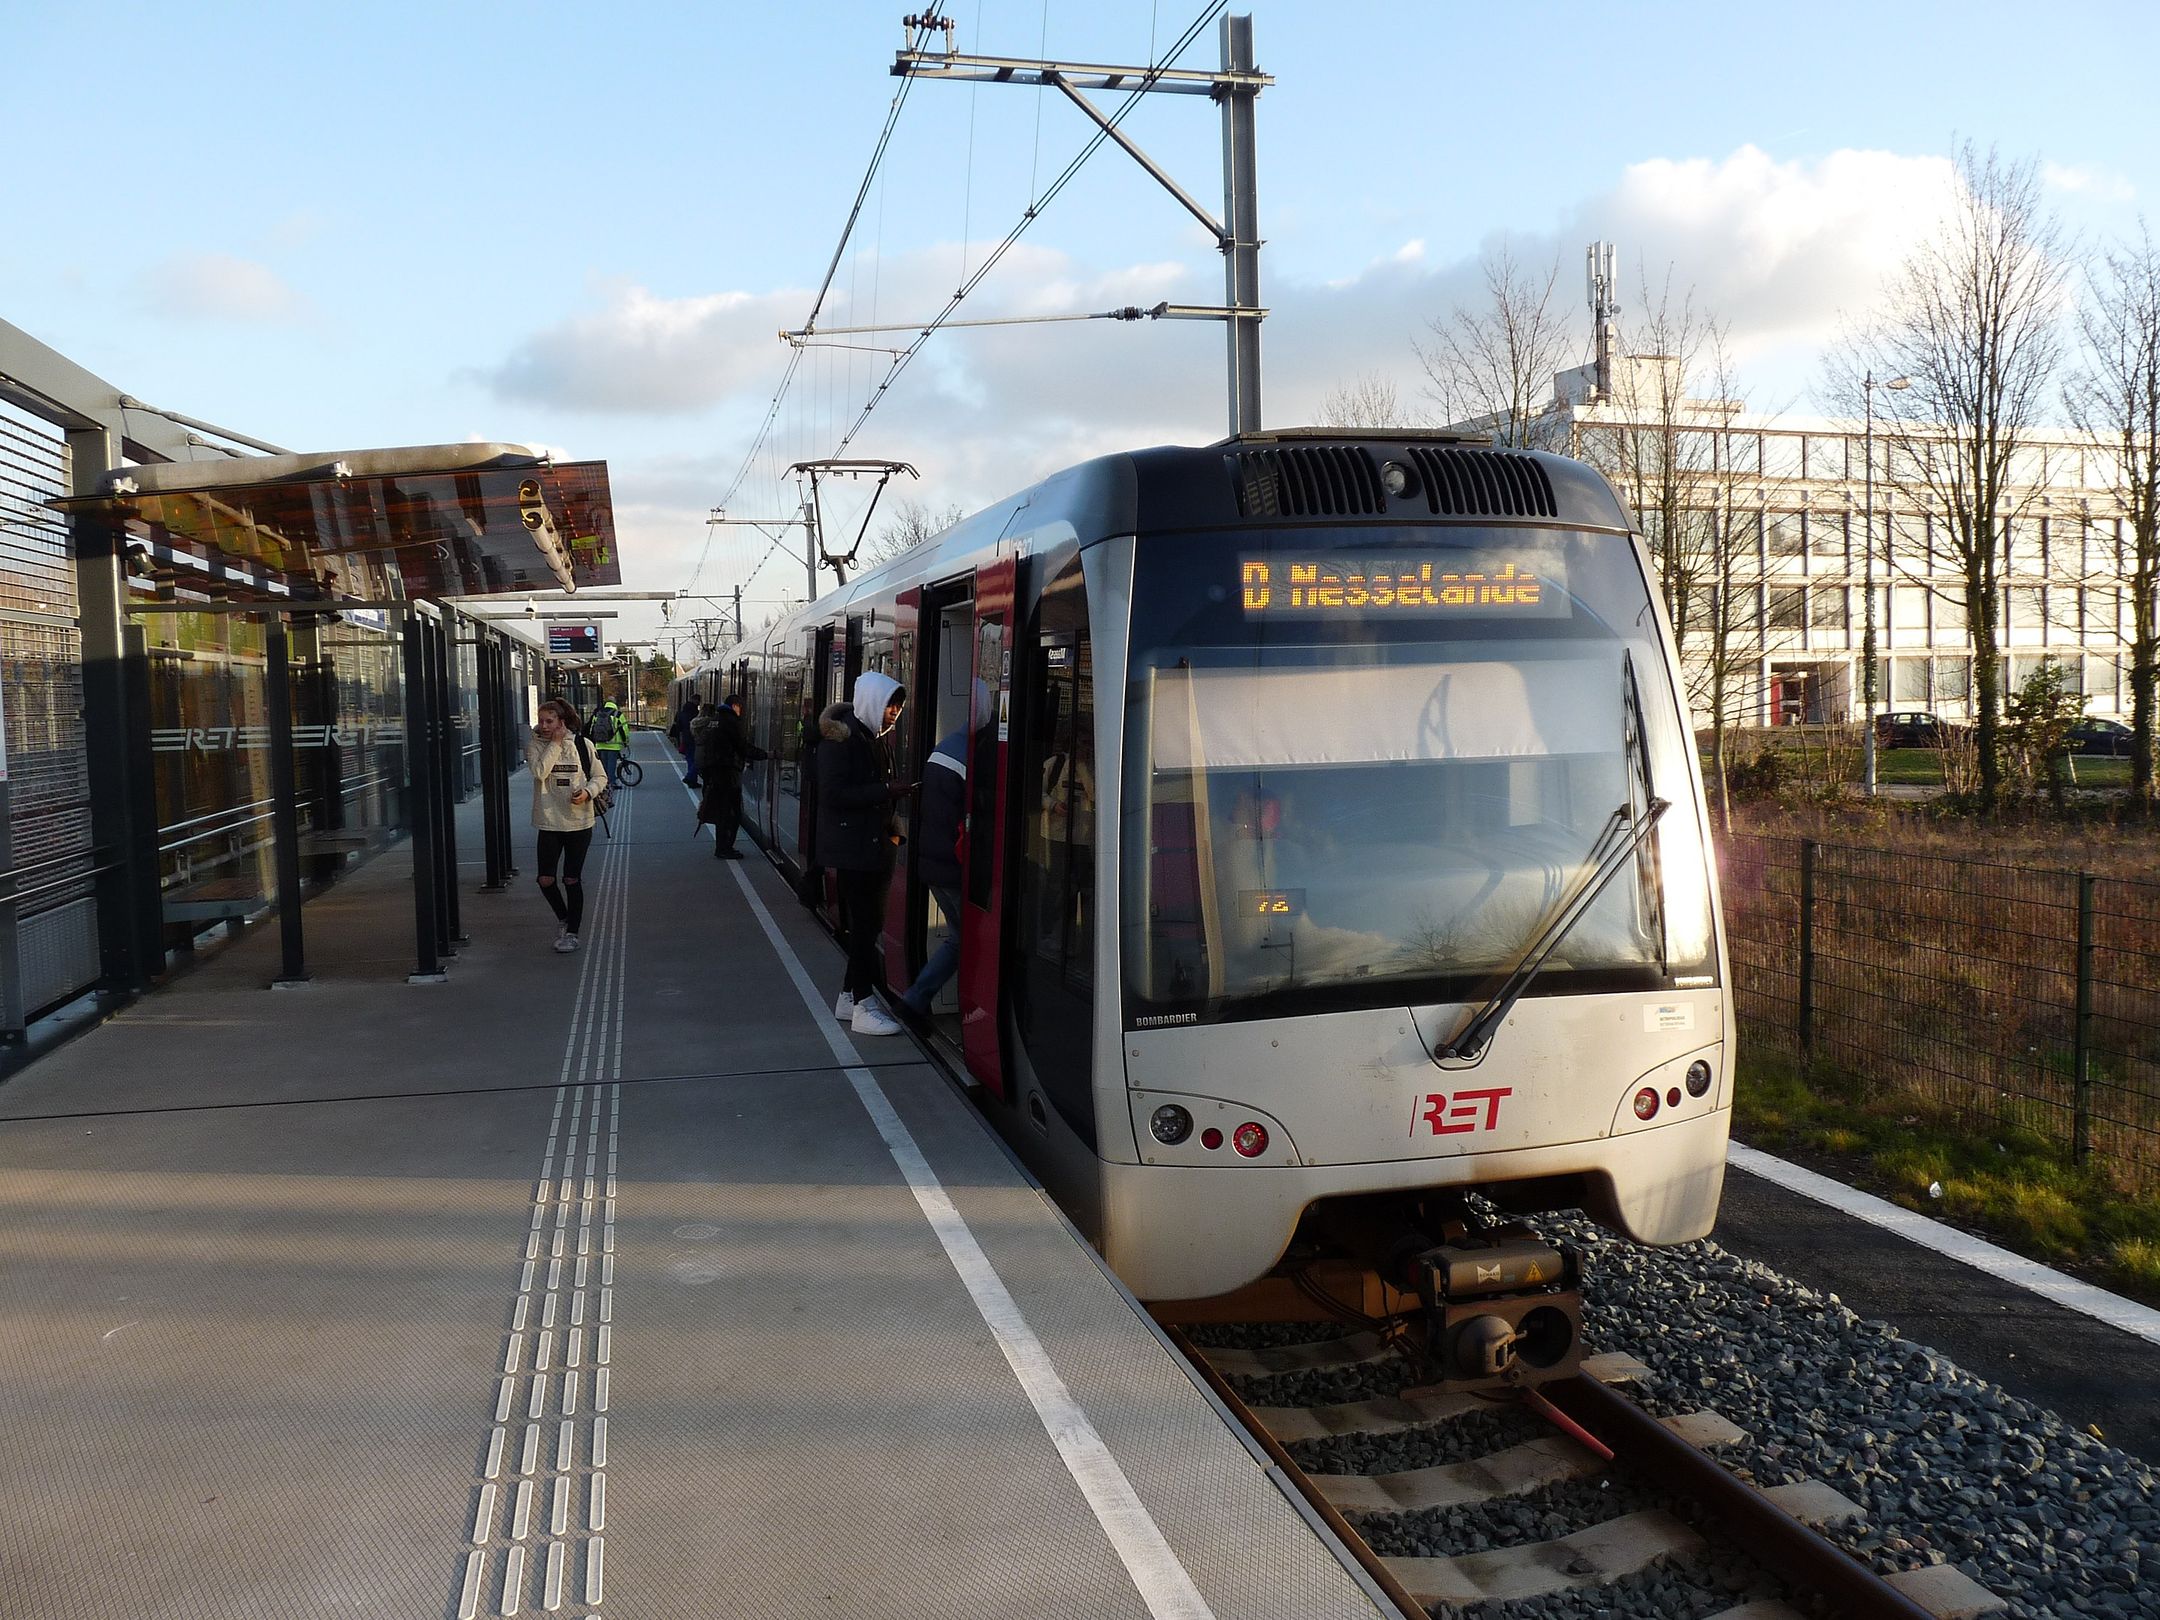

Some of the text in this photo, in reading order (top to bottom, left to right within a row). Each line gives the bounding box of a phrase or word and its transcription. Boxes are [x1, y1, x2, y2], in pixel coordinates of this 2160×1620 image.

[1242, 562, 1270, 609] D
[185, 727, 237, 750] RET
[1136, 1013, 1198, 1027] BOMBARDIER
[1409, 1087, 1513, 1138] RET
